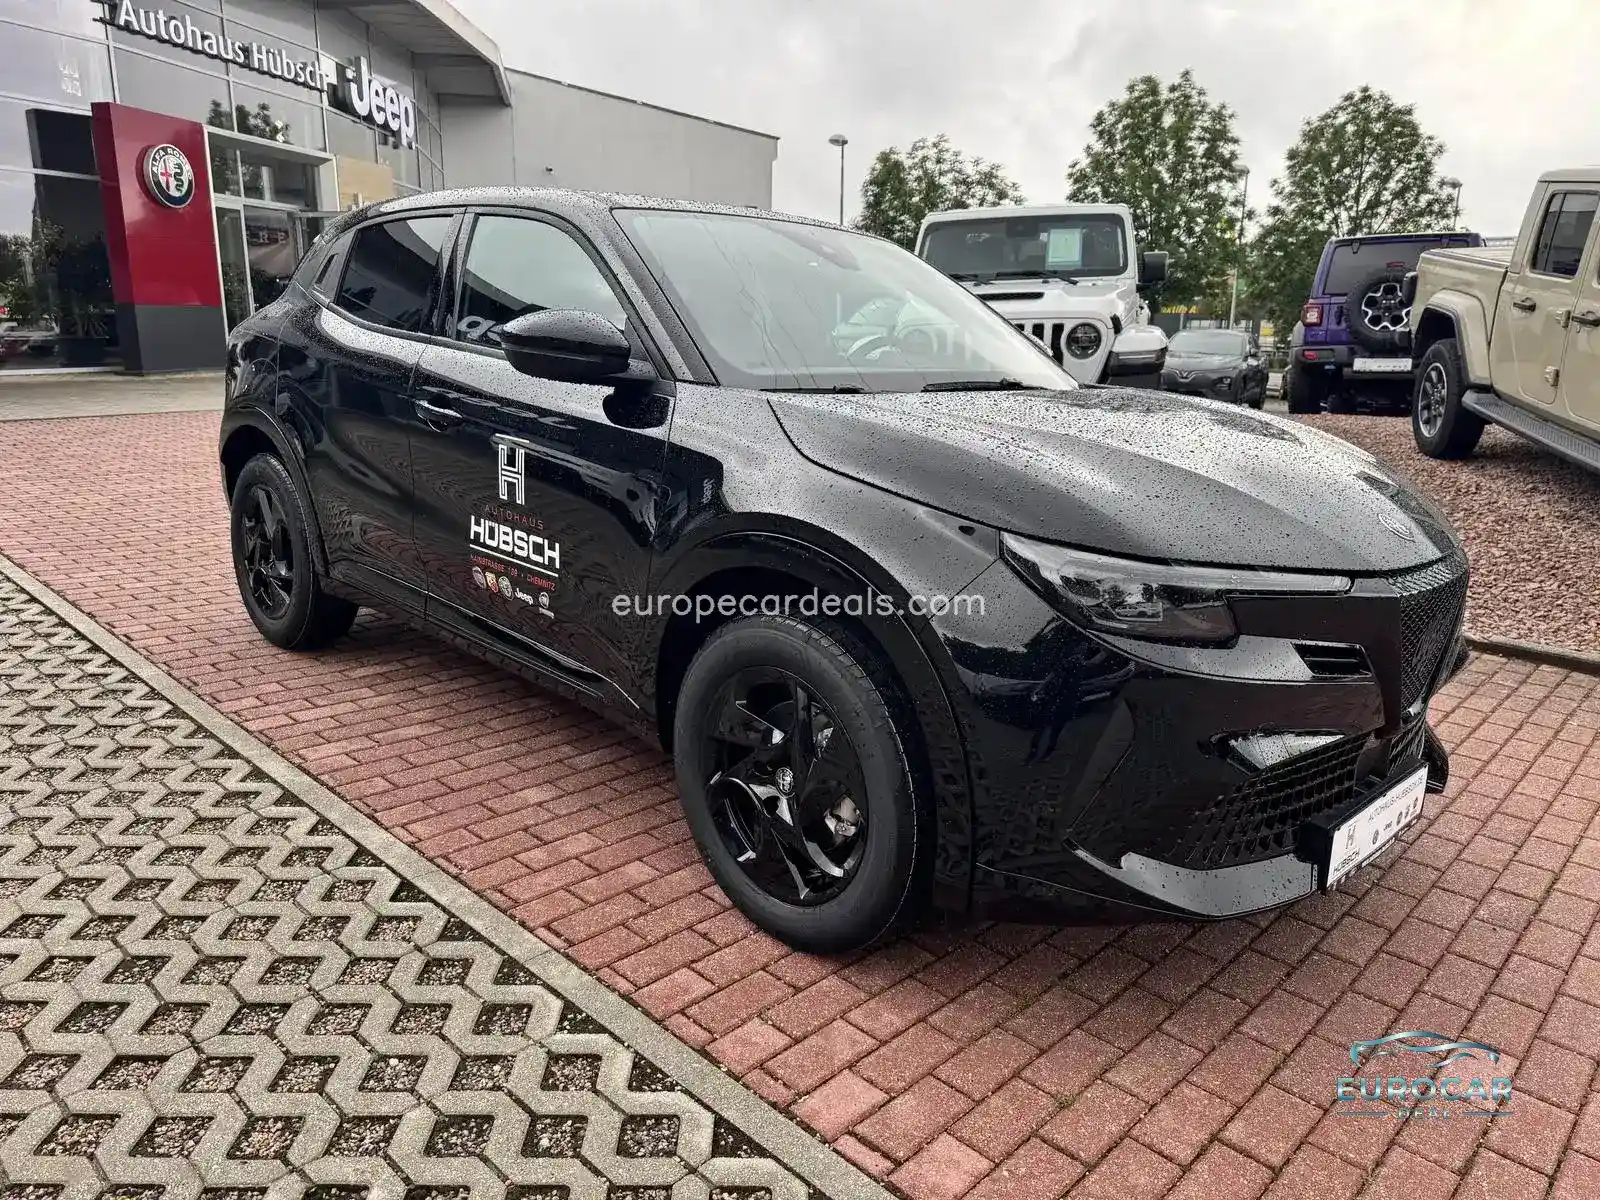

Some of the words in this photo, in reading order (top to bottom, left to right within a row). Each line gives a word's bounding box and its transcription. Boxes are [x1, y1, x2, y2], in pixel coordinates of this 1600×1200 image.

[118, 0, 246, 64] Autohaus
[252, 41, 329, 92] Hübsch
[345, 55, 415, 147] Jeep
[152, 149, 166, 174] ALFA
[484, 504, 545, 531] AUTOHAUS
[469, 514, 560, 569] HÜBSCH
[514, 587, 534, 606] Jeep
